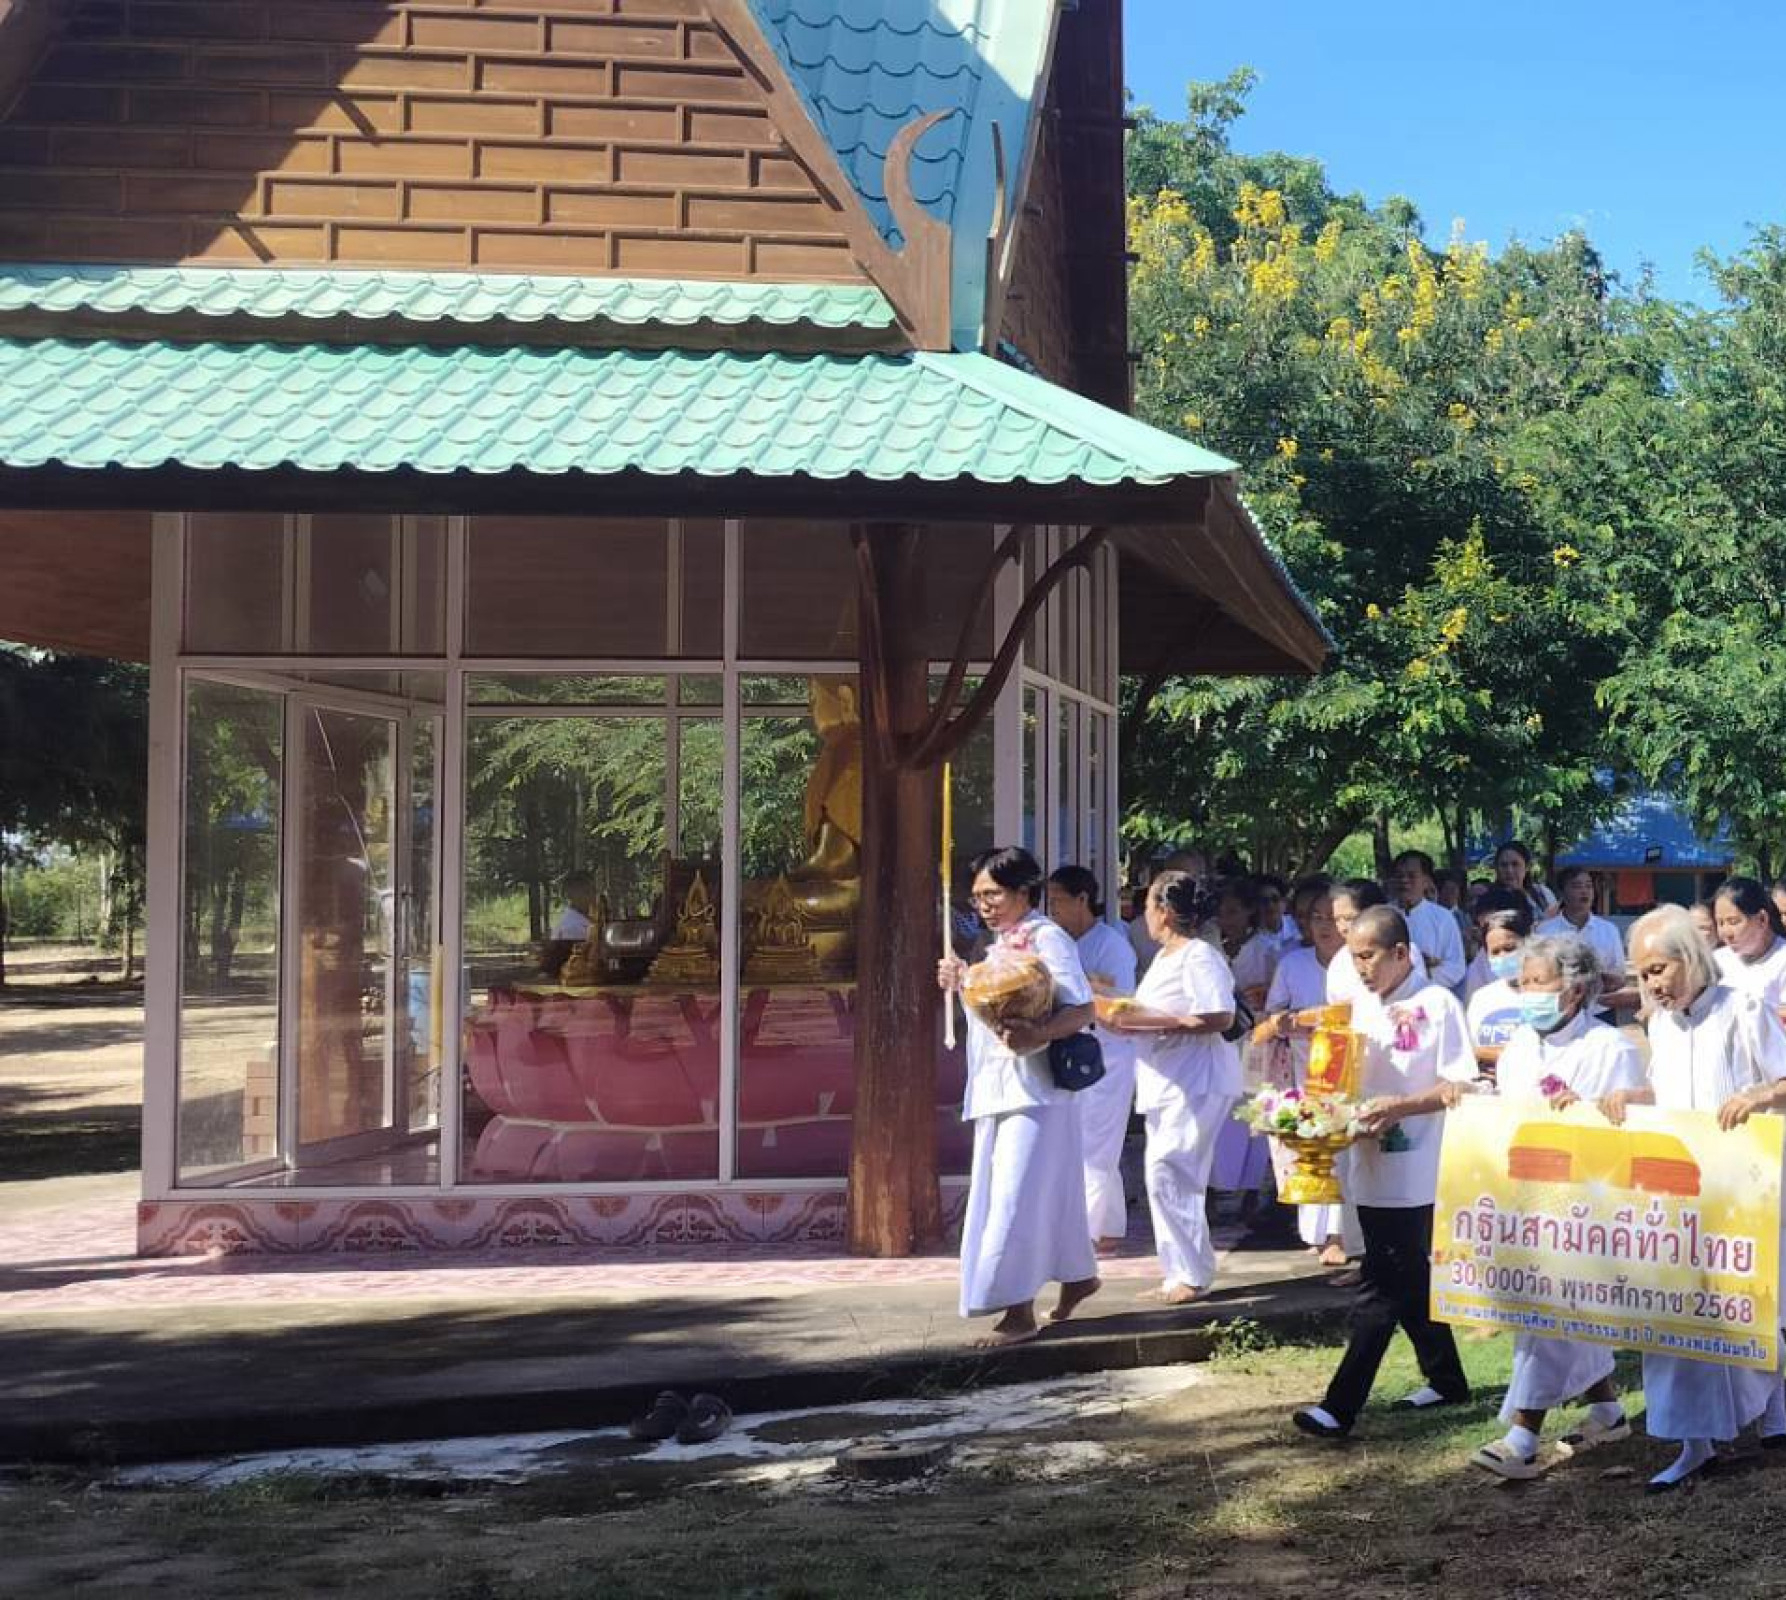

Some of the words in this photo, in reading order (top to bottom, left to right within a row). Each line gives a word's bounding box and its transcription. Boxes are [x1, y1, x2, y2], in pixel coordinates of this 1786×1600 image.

[1455, 1197, 1753, 1273] กฐินสามัคคีทั่วไทย
[1451, 1262, 1551, 1296] 30,000วัด
[1560, 1274, 1683, 1313] พุทธศักราช
[1693, 1291, 1753, 1324] 2568
